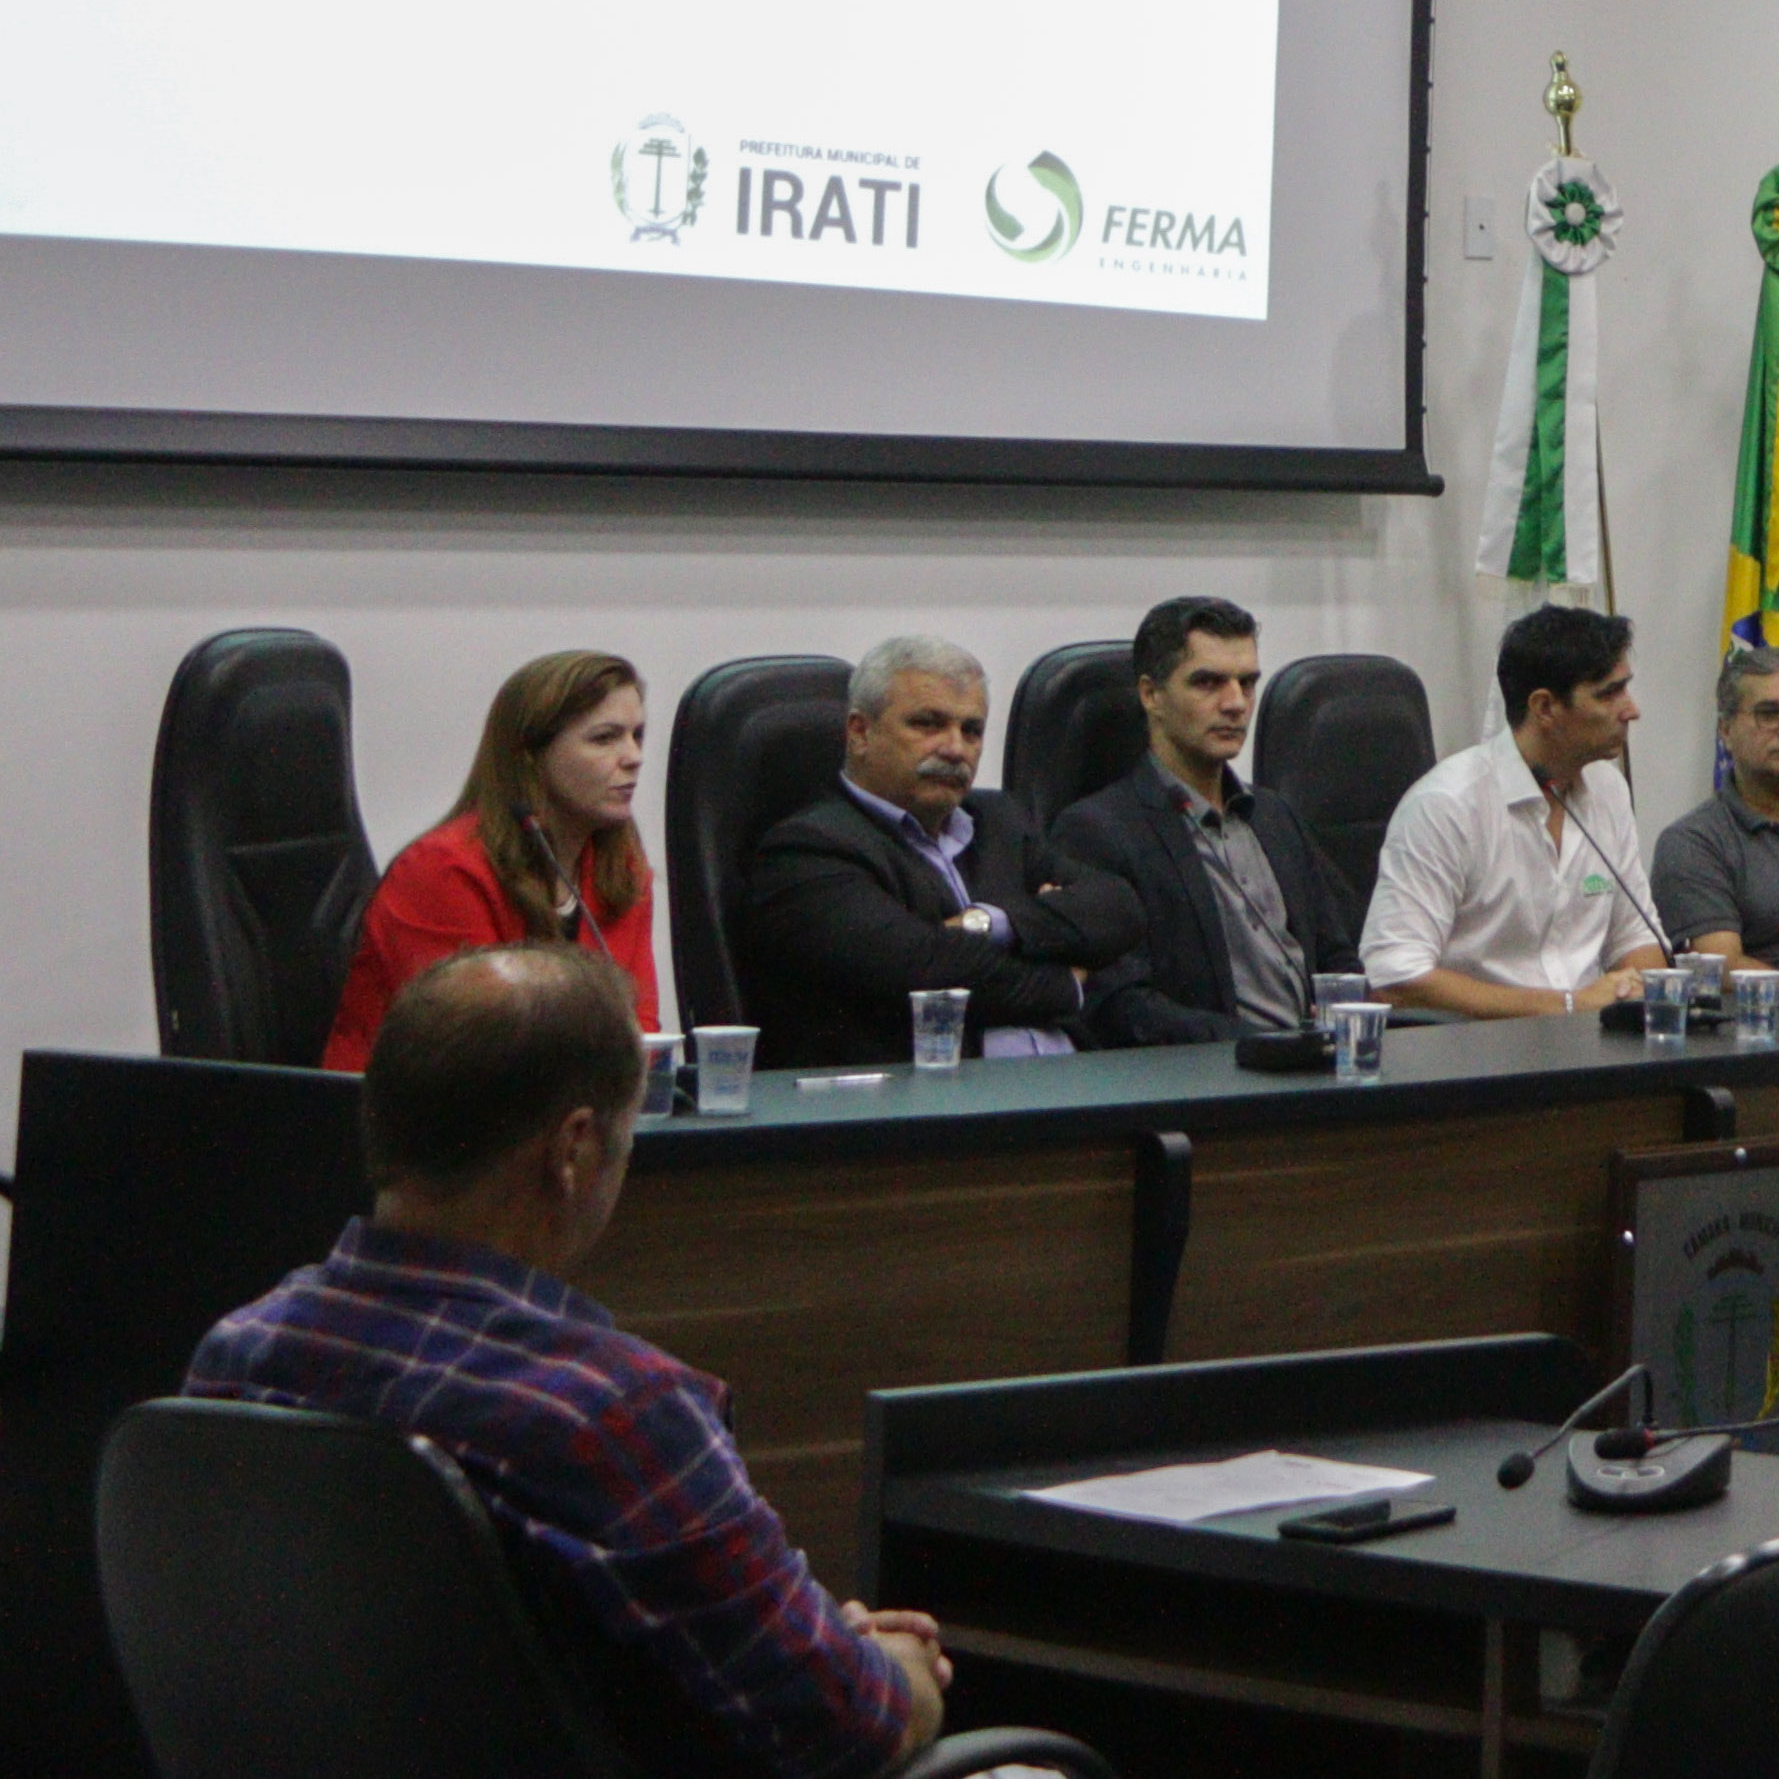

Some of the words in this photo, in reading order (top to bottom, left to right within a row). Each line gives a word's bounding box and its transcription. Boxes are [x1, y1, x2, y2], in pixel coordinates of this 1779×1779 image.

[739, 139, 823, 160] PREFEITURA
[827, 148, 899, 168] MUNICIPAL
[904, 156, 921, 170] DE
[736, 166, 920, 249] IRATI
[1101, 204, 1248, 257] FERMA
[1099, 257, 1248, 281] ENGENHARIA
